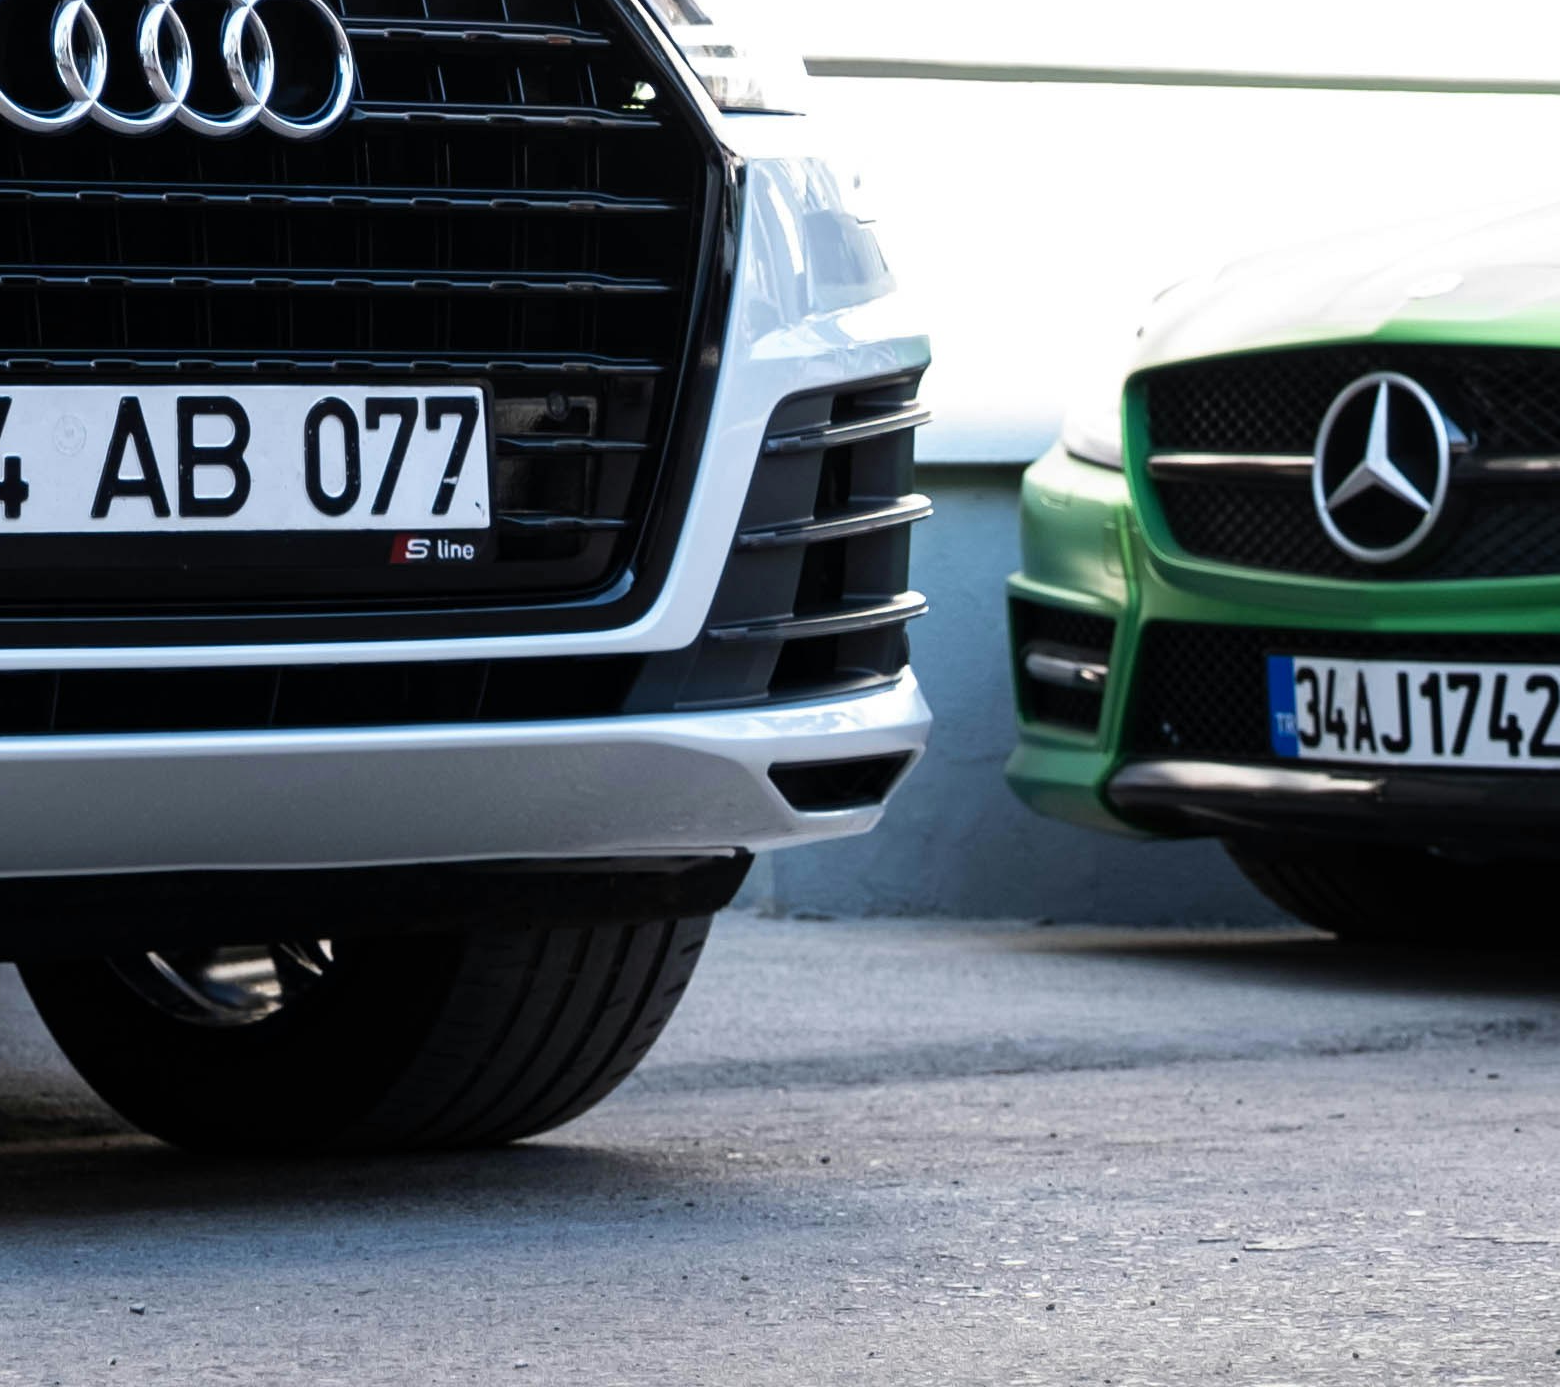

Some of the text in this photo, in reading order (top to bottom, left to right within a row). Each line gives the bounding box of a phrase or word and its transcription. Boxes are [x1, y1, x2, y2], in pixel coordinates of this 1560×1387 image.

[89, 396, 251, 518] AB
[303, 396, 479, 517] 077
[405, 539, 475, 560] S line
[1275, 713, 1297, 736] TR
